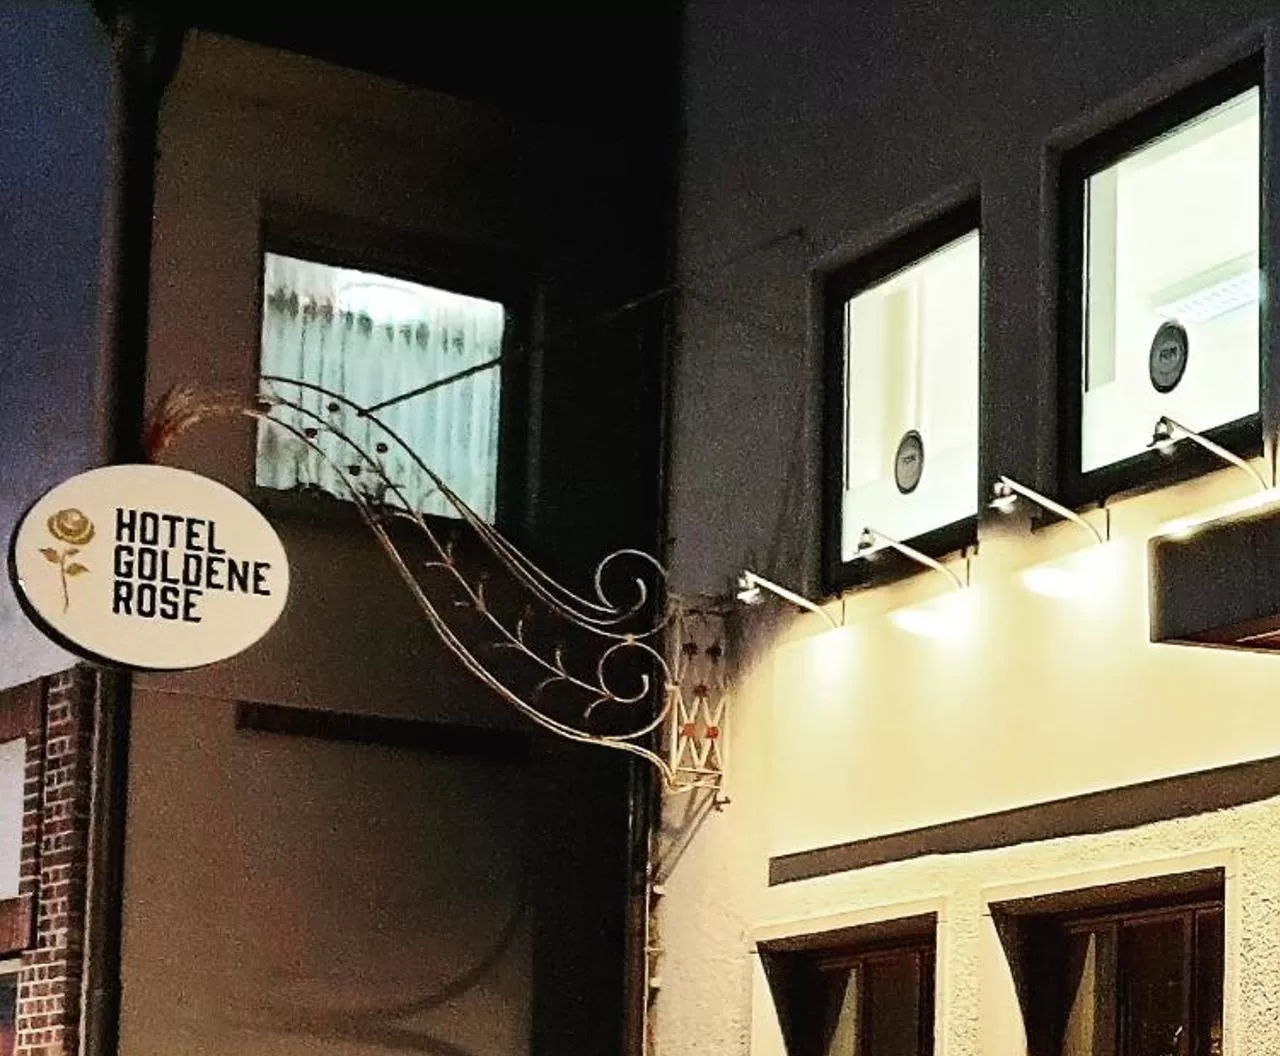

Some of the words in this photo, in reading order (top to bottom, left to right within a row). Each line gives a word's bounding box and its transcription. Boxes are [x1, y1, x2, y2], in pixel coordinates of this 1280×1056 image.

[116, 508, 226, 555] HOTEL
[113, 545, 271, 596] GOLDENE
[112, 580, 202, 623] ROSE
